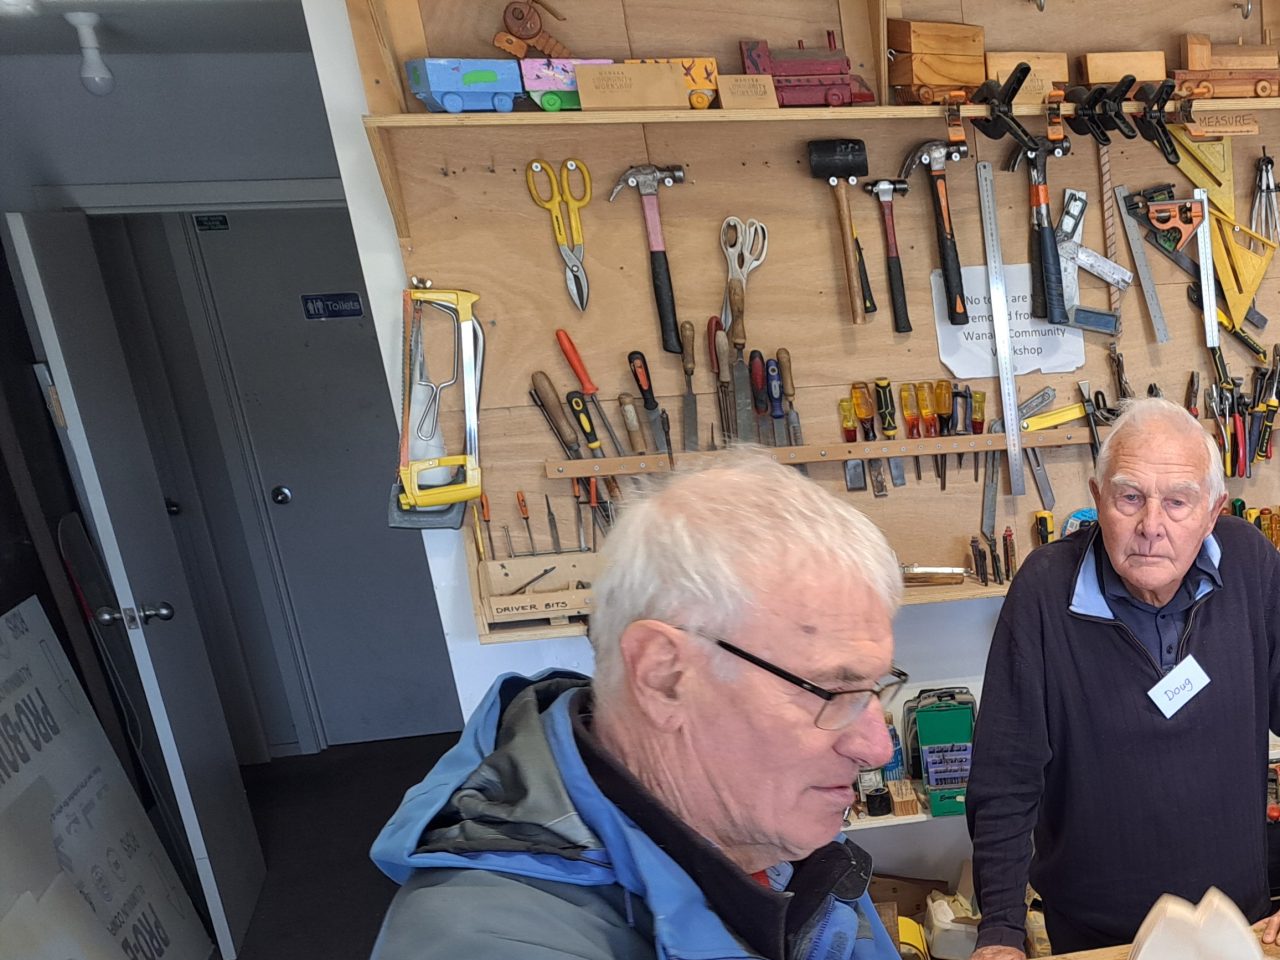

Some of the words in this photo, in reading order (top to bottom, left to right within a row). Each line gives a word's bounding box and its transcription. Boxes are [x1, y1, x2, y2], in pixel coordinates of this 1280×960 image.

[1199, 114, 1251, 127] MEASURE
[326, 301, 360, 311] Toilets
[966, 296, 980, 305] No
[1012, 295, 1027, 303] are
[968, 311, 1012, 323] remod
[1015, 311, 1033, 320] fro
[963, 331, 996, 342] Wana
[1009, 327, 1066, 339] Community
[496, 604, 538, 614] DRIVER
[544, 601, 568, 609] BITS
[1164, 678, 1194, 701] Doug
